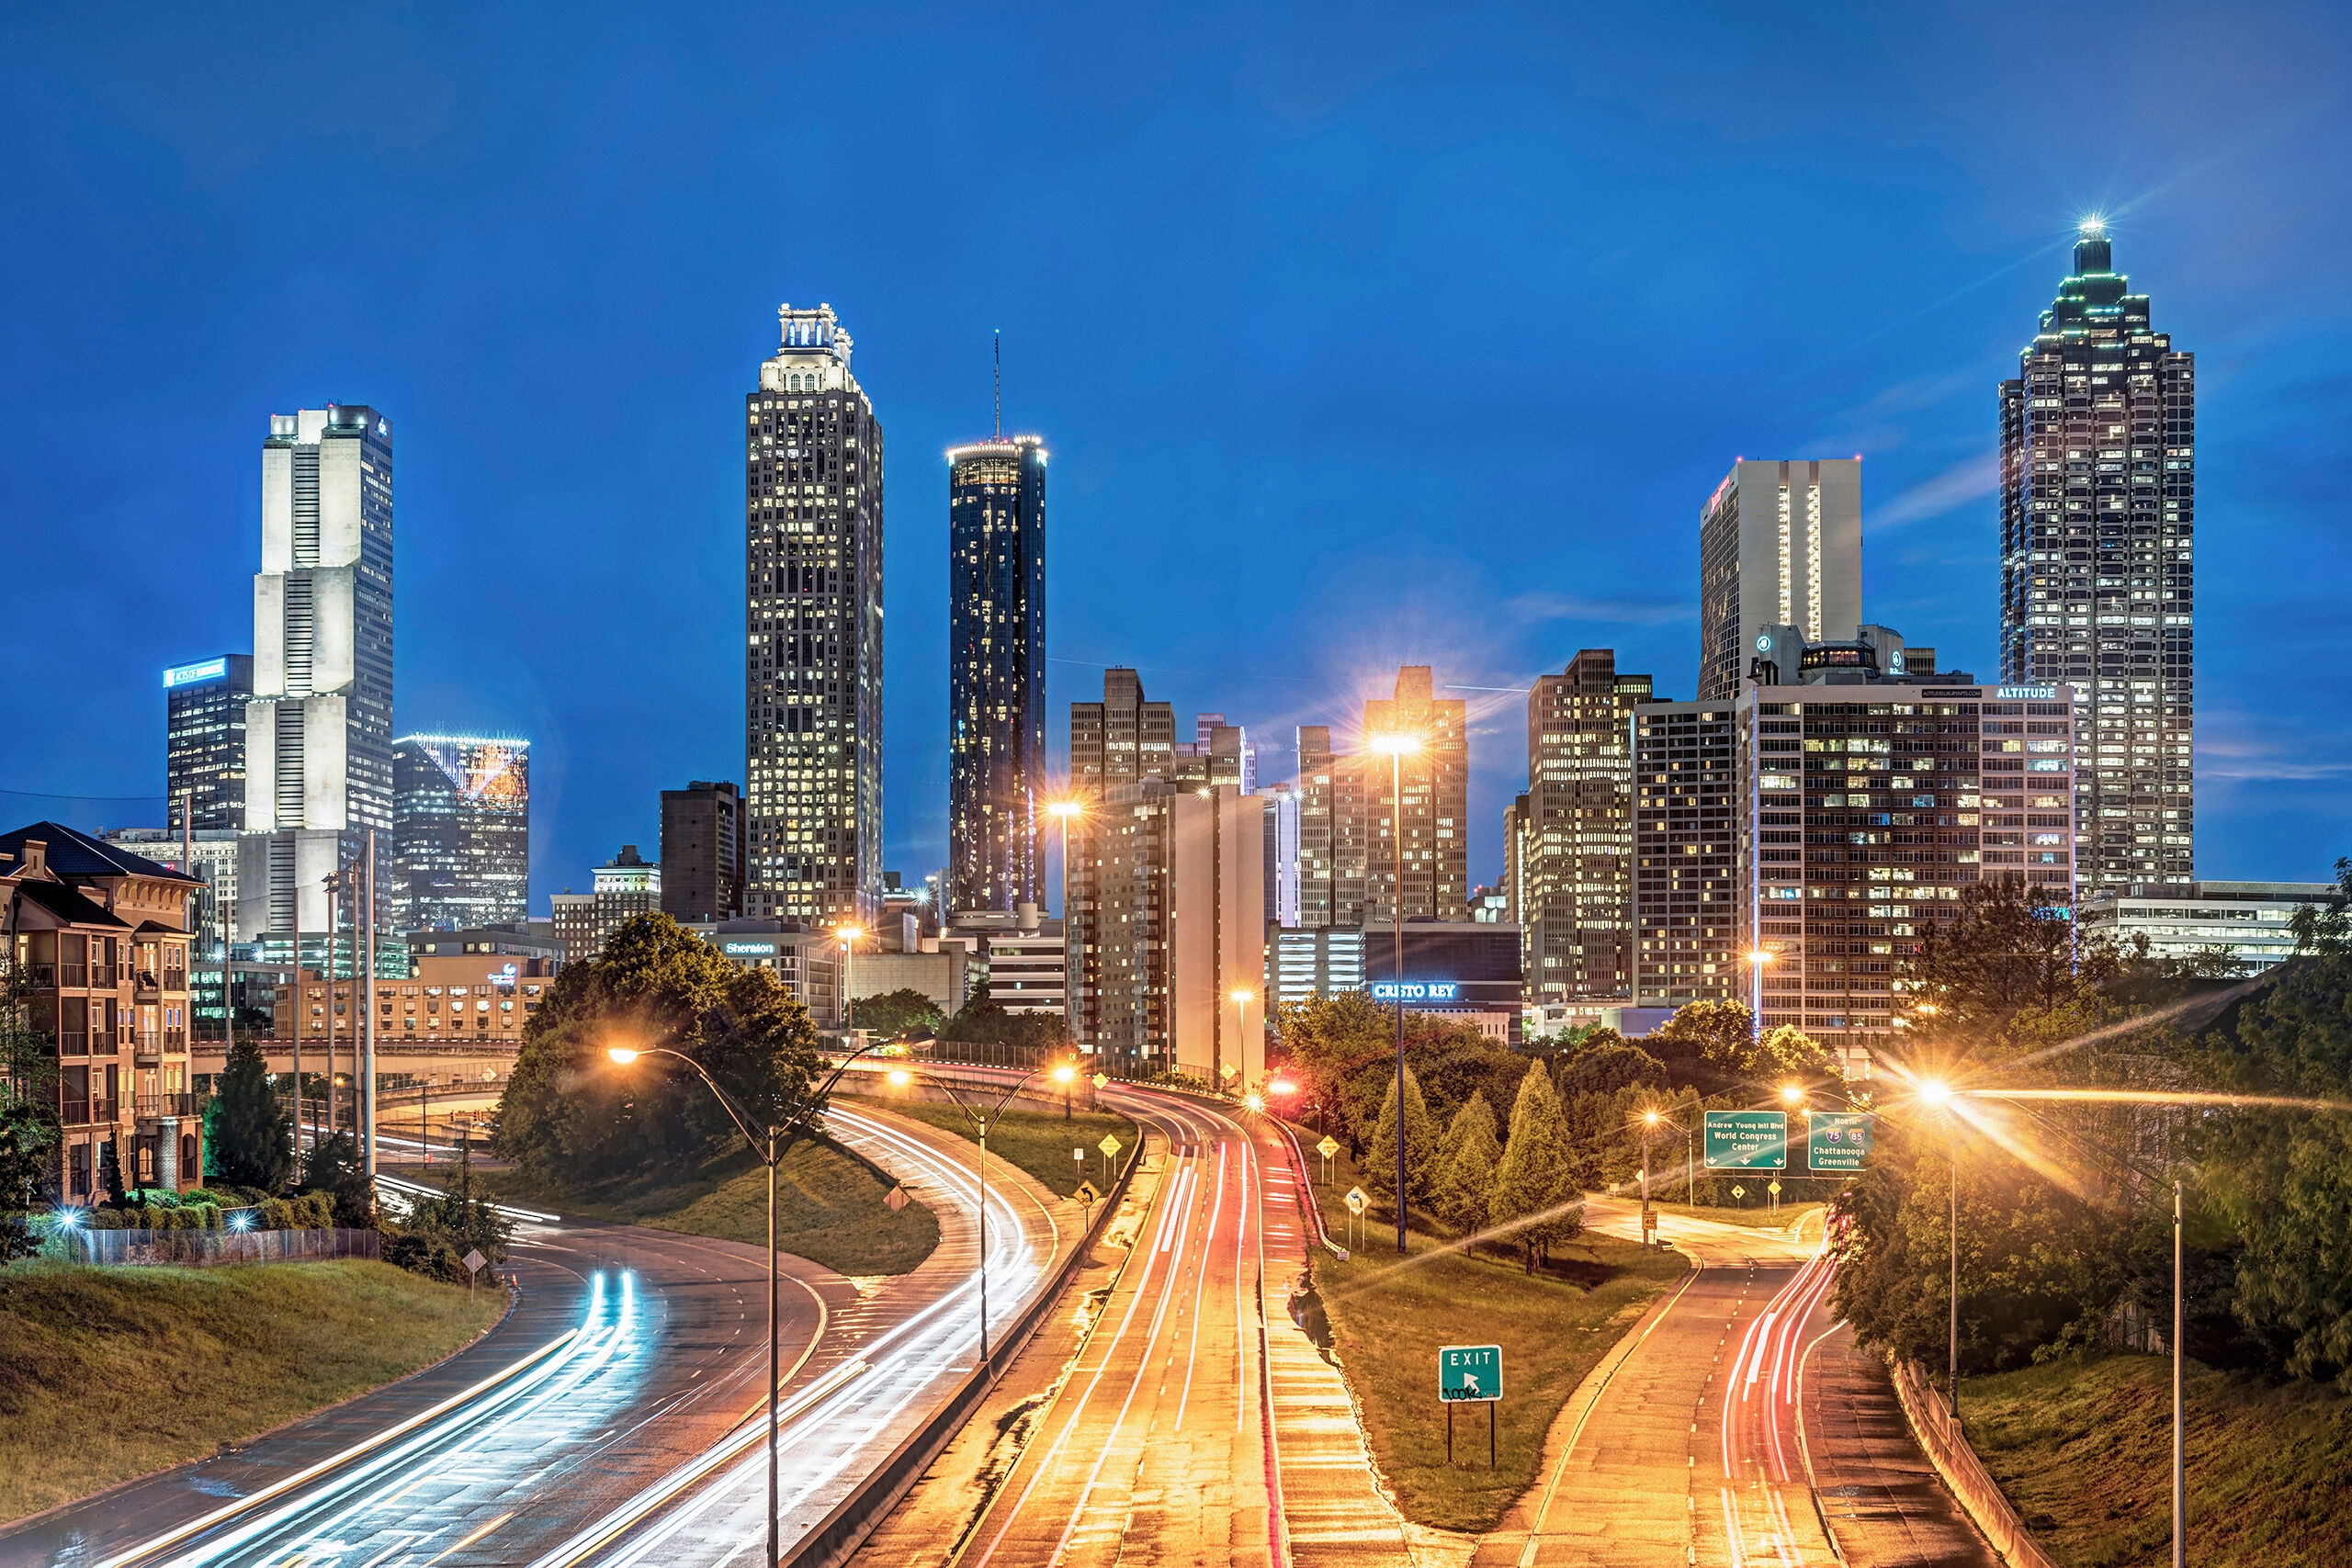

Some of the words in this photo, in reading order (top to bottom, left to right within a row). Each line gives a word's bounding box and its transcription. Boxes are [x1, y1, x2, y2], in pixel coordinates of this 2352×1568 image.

[1996, 687, 2056, 699] ALTITUDE
[726, 942, 775, 954] Sheraton
[1374, 984, 1426, 998] CRISTO
[1428, 984, 1456, 998] REY
[1735, 1122, 1757, 1131] Young
[1713, 1131, 1737, 1140] World
[1739, 1132, 1778, 1142] Congress
[1828, 1131, 1840, 1140] 75
[1850, 1133, 1862, 1141] 85
[1732, 1143, 1759, 1151] Center
[1814, 1146, 1865, 1156] Chattanooga
[1818, 1156, 1860, 1167] Greenville
[1450, 1351, 1490, 1366] EXIT
